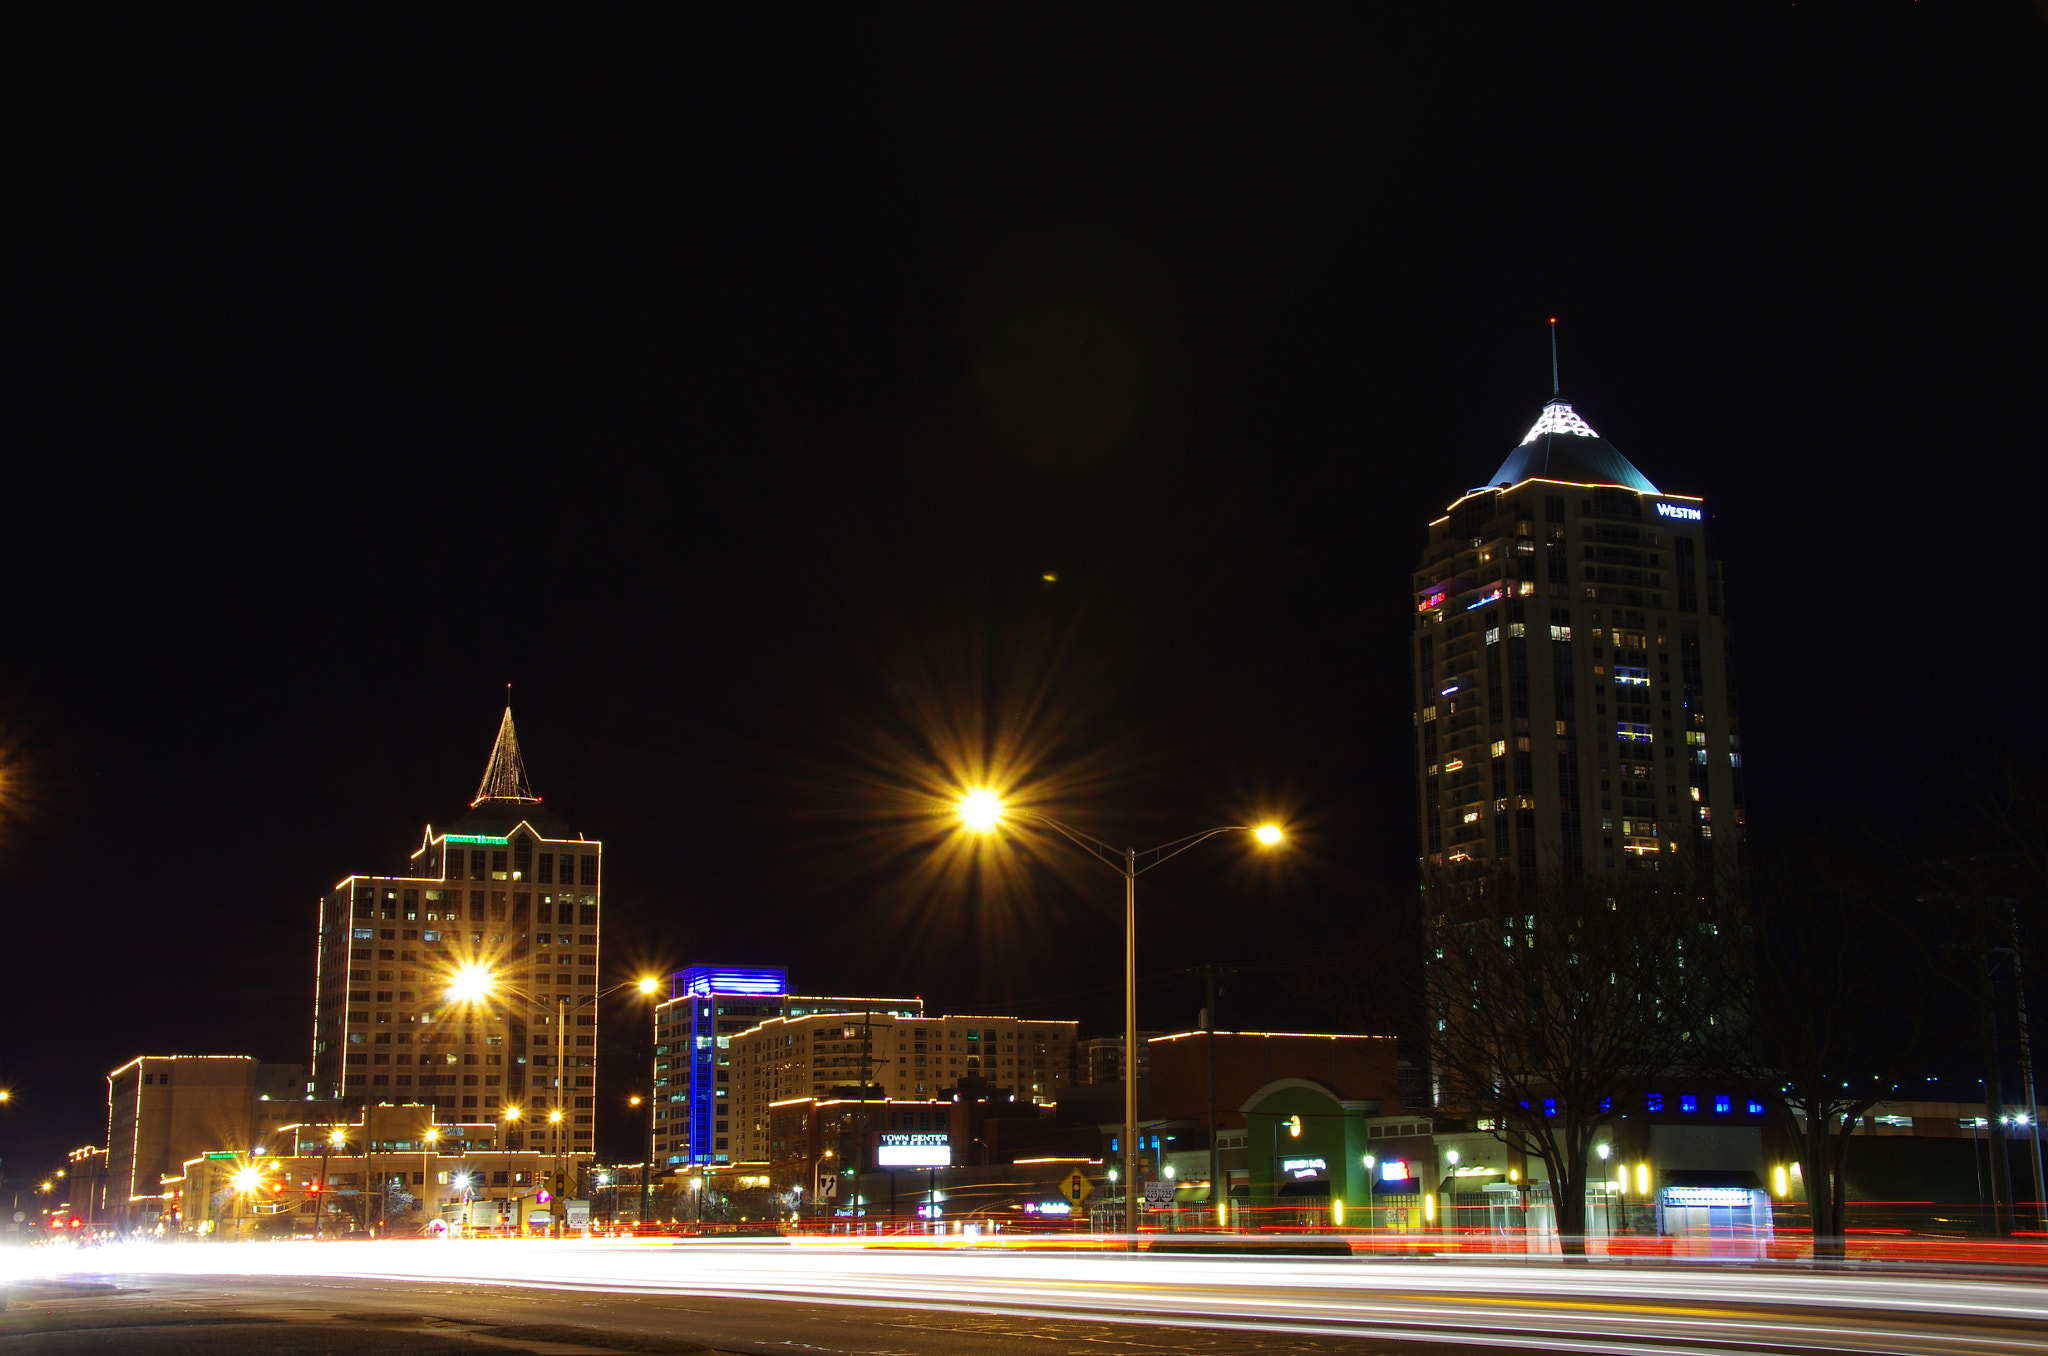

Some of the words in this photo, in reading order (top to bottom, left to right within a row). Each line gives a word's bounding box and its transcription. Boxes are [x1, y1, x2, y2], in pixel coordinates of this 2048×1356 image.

[1656, 503, 1701, 520] WESTIN
[881, 1134, 909, 1142] TOWN
[910, 1134, 948, 1142] CENTER
[1146, 1190, 1158, 1199] 225
[1161, 1190, 1172, 1199] 225
